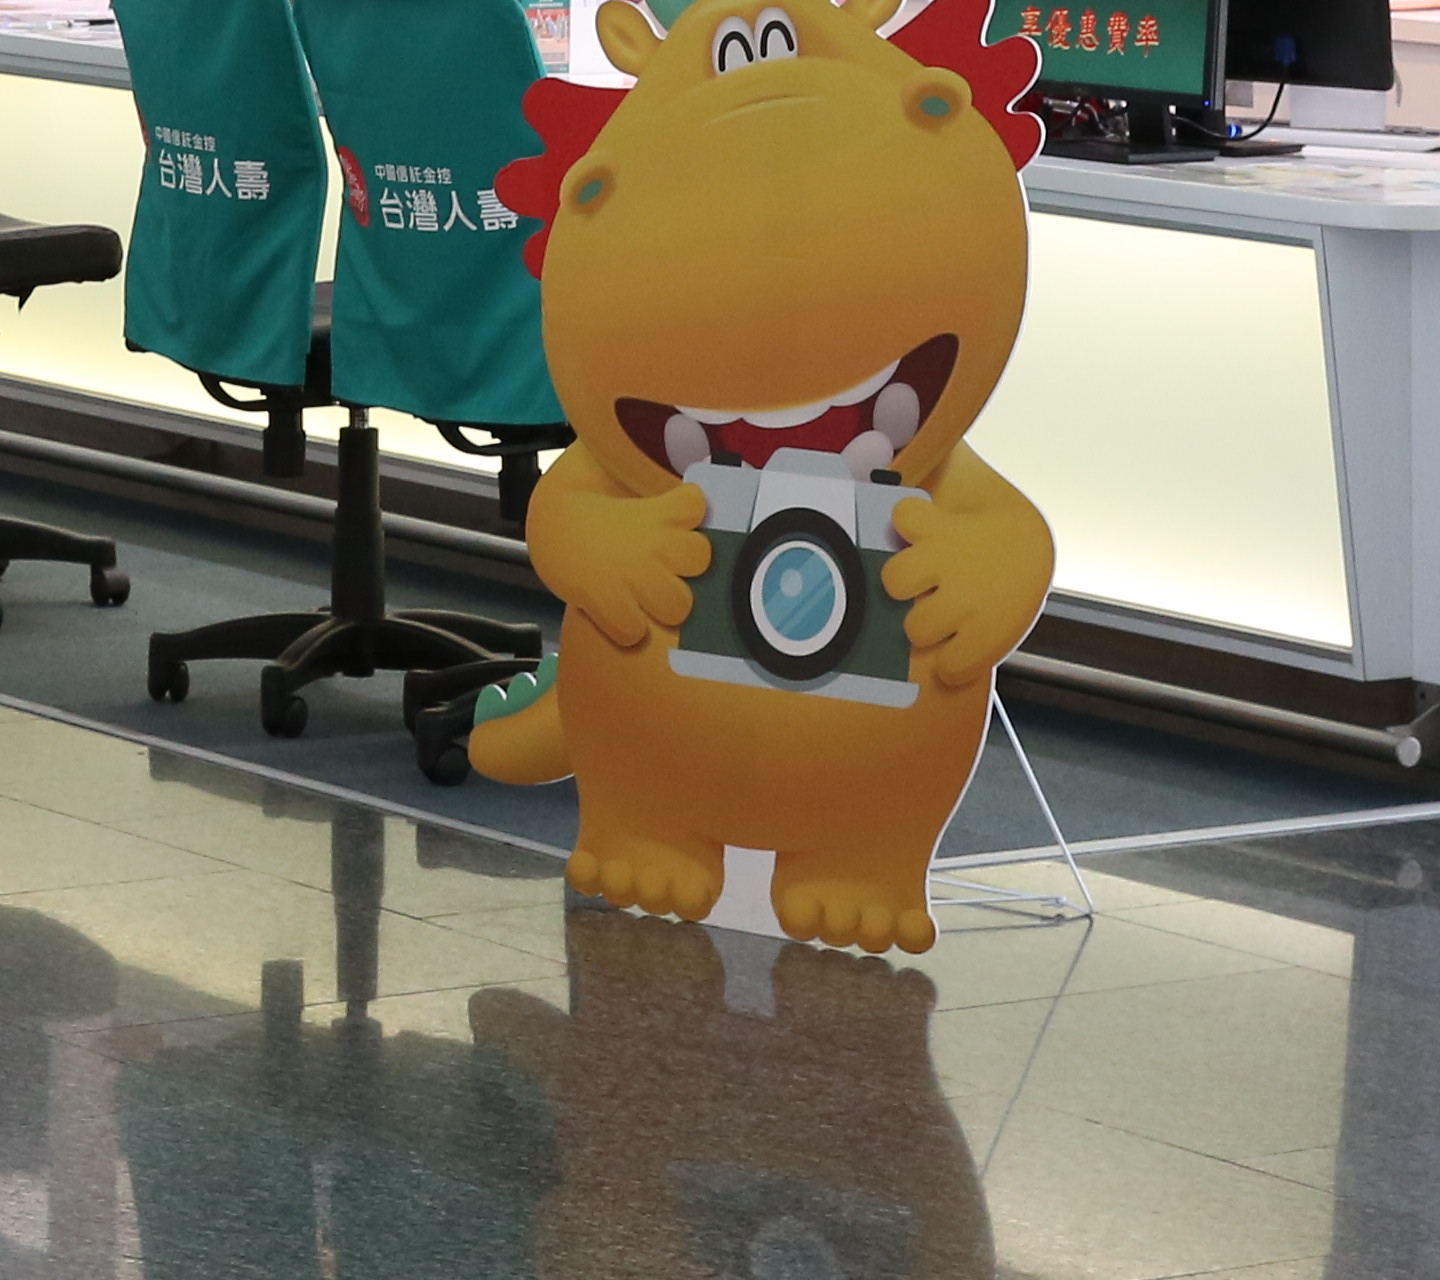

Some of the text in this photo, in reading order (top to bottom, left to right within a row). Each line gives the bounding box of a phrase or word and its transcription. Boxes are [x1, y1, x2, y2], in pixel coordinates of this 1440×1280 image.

[1016, 6, 1161, 60] 享優惠費率
[154, 125, 218, 153] 中國信託金控
[157, 148, 272, 202] 台灣人壽
[374, 163, 453, 186] 中國信託金控
[378, 186, 521, 234] 台灣人壽
